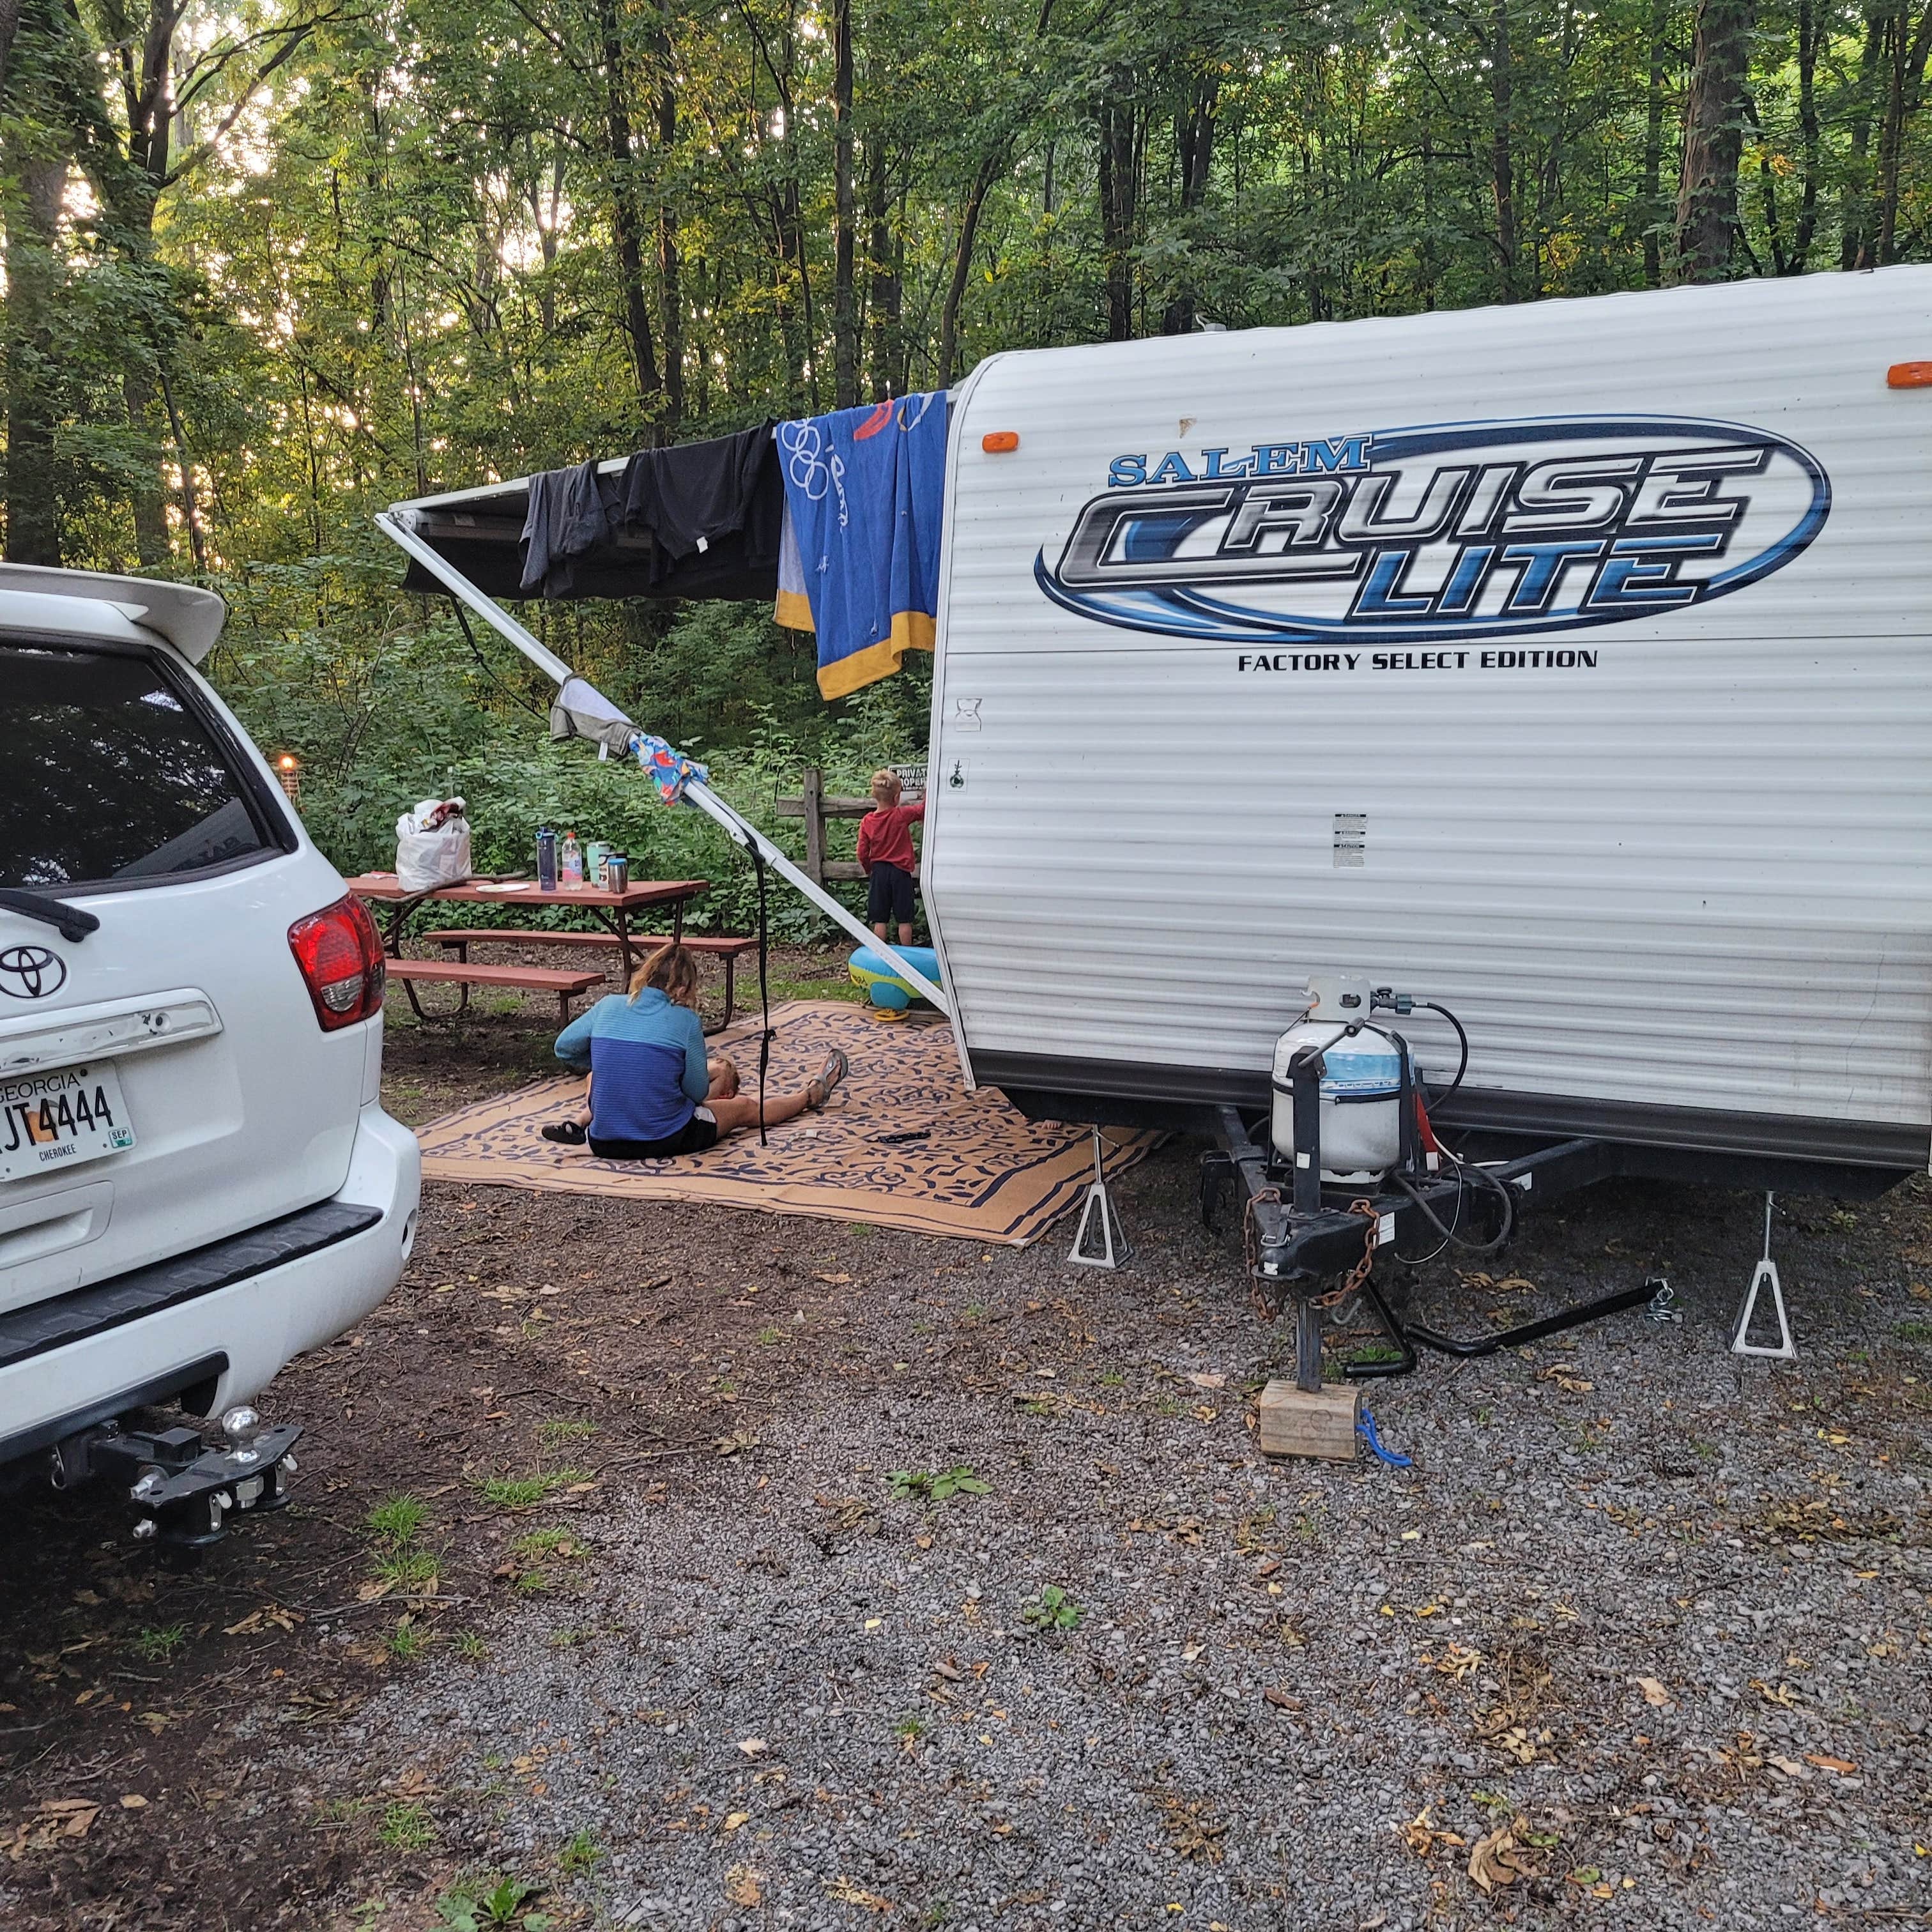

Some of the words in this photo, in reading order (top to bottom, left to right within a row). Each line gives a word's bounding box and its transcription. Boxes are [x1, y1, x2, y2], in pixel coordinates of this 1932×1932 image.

[1108, 433, 1373, 489] SALEM
[1056, 447, 1767, 588] CRUISE
[1349, 532, 1725, 618] LITE
[1238, 653, 1361, 671] FACTORY
[1372, 652, 1470, 670] SELECT
[1480, 650, 1598, 668] EDITION
[896, 767, 927, 778] PRIVAT
[0, 1085, 114, 1154] JT4444
[111, 1129, 127, 1140] SEP
[38, 1143, 77, 1162] CHEROKEE
